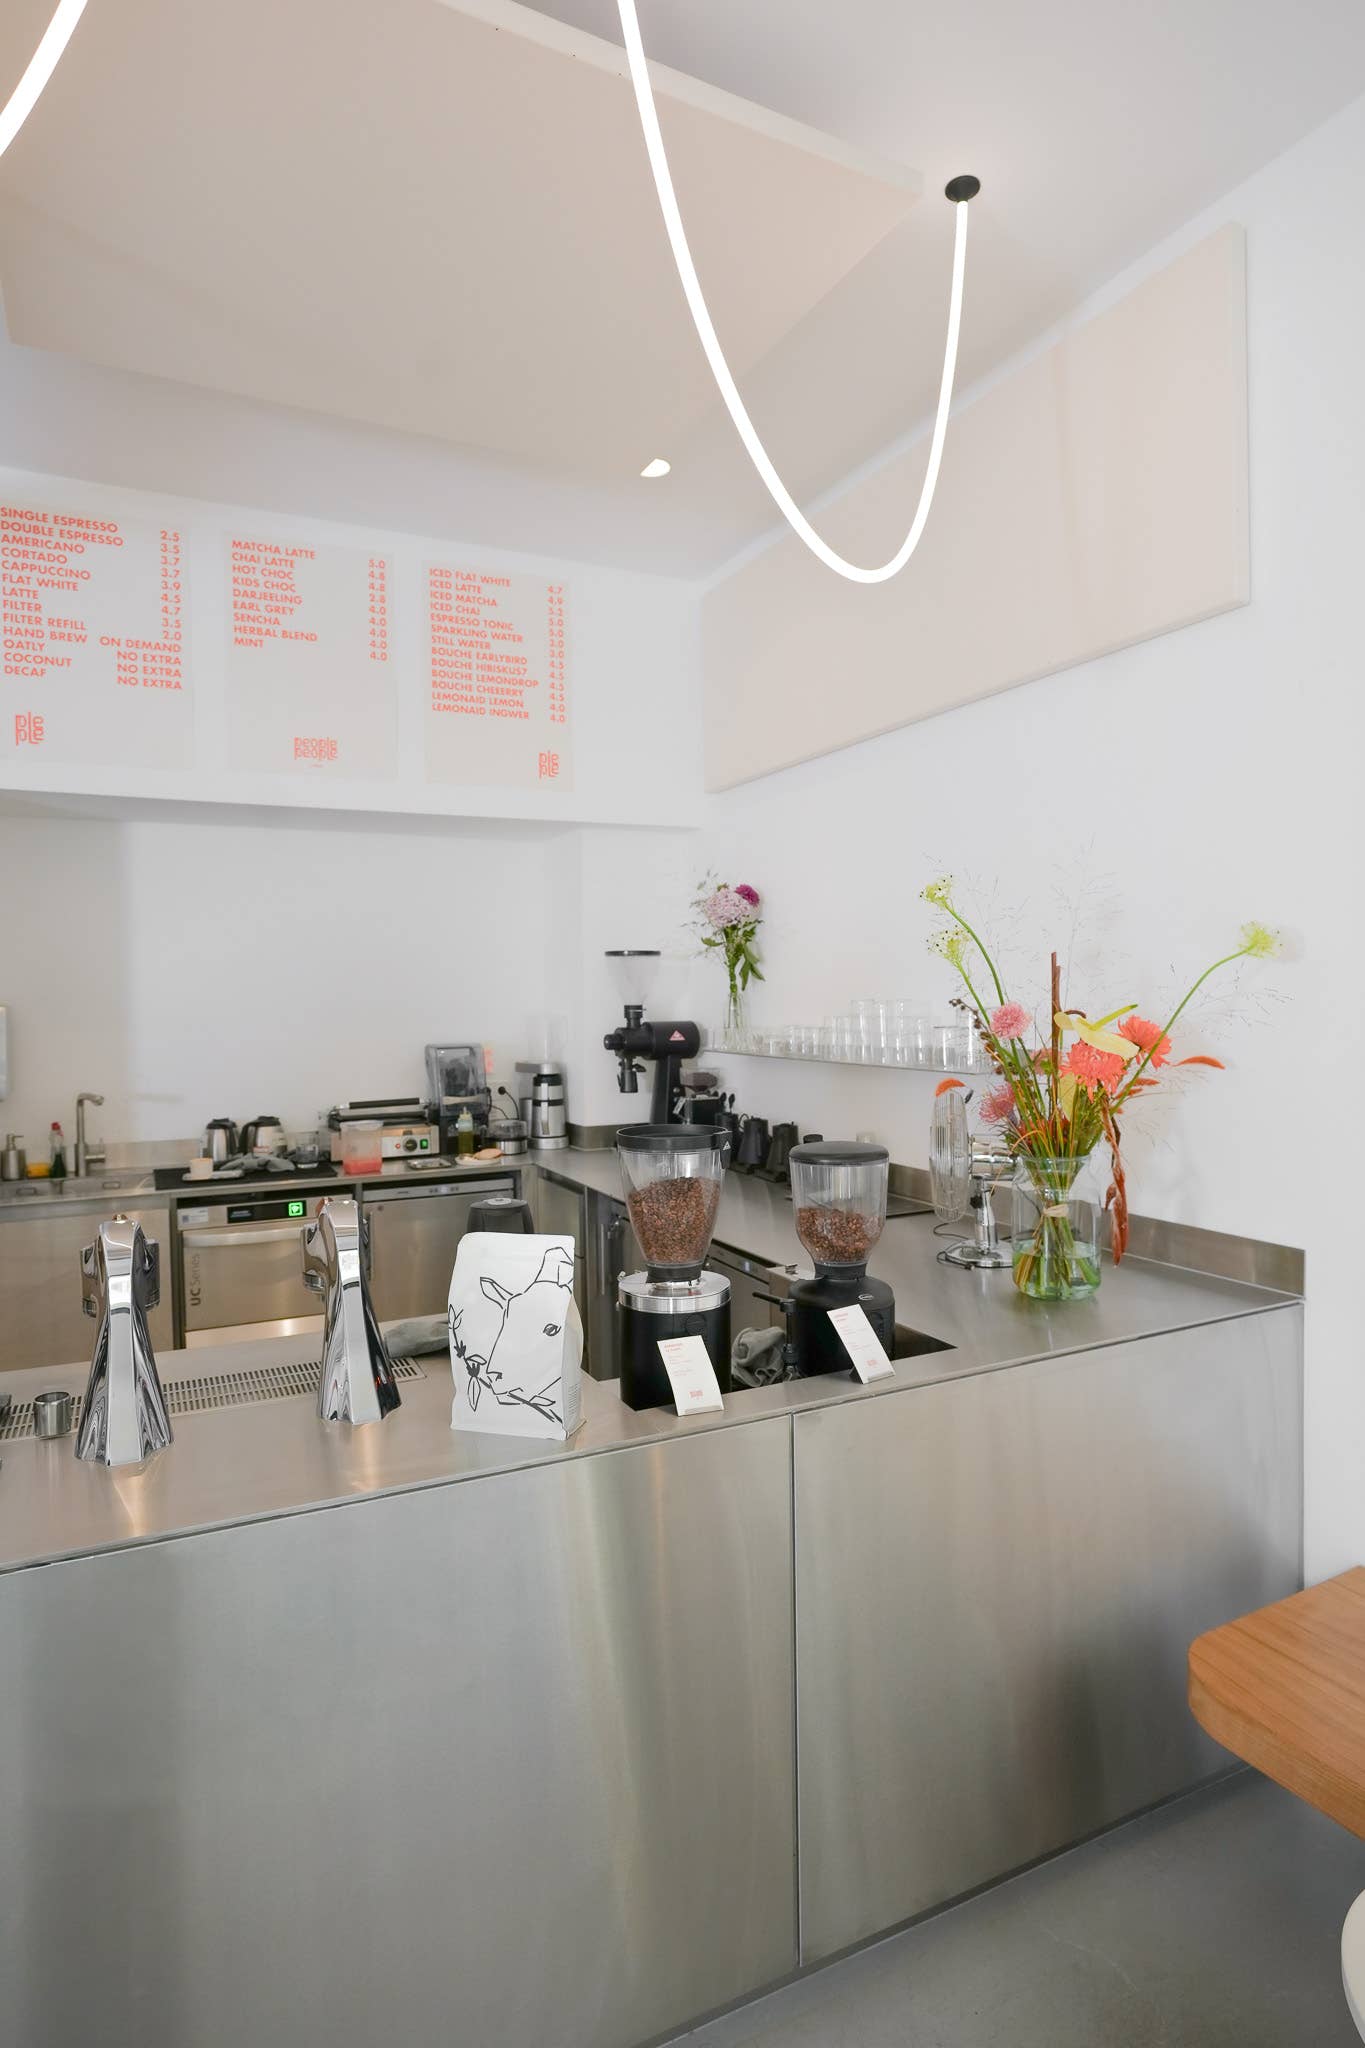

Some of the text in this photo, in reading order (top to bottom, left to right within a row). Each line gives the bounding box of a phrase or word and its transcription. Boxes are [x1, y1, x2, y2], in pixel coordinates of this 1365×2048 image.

[0, 506, 180, 542] SINGLE ESPRESSO 2.5
[0, 520, 180, 554] DOUBLE ESPRESSO 3.5
[1, 534, 180, 566] AMERICANO 3.7
[232, 540, 281, 554] MATCHA
[285, 547, 316, 560] LATTE
[232, 552, 260, 564] CHAI
[264, 556, 295, 568] LATTE
[1, 547, 180, 578] CORTADO 3.7
[232, 564, 257, 575] HOT
[261, 567, 294, 580] CHOC
[1, 560, 181, 591] CAPPUCCINO 3.9
[232, 576, 260, 588] KIDS
[263, 580, 296, 593] CHOC
[430, 568, 452, 578] ICED
[455, 571, 477, 581] FLAT
[481, 576, 511, 587] WHITE
[430, 579, 452, 589] ICED
[455, 583, 482, 593] LATTE
[2, 573, 181, 604] FLAT WHITE 4.5
[430, 591, 452, 600] ICED
[456, 595, 497, 606] MATCHA
[2, 586, 181, 616] LATTE 4.7
[233, 588, 387, 615] DARJEELING 4.0
[431, 602, 453, 612] ICED
[456, 605, 480, 615] CHAI
[3, 599, 182, 629] FILTER 3.5
[233, 600, 387, 627] EARL GREY 4.0
[431, 613, 480, 626] ESPRESSO
[483, 620, 513, 631] TONIC
[3, 612, 182, 641] FILTER REFILL 2.0
[233, 612, 387, 638] SENCHA 4.0
[432, 624, 487, 638] SPARKLING
[491, 631, 523, 643] WATER
[3, 626, 182, 653] HAND BREW ON DEMAND
[234, 625, 388, 650] HERBAL BLEND 4.0
[432, 635, 454, 646] STILL
[458, 639, 490, 650] WATER
[3, 639, 182, 665] OATLY NO EXTRA
[234, 637, 388, 661] MINT 4.0
[432, 647, 472, 659] BOUCHE
[476, 652, 527, 665] EARLYBIRD
[3, 652, 182, 678] COCONUT NO EXTRA
[432, 658, 472, 670] BOUCHE
[4, 665, 183, 690] DECAF NO EXTRA
[432, 669, 472, 681] BOUCHE
[476, 674, 539, 687] LEMONDROP
[432, 680, 472, 692] BOUCHE
[432, 692, 486, 704] LEMONAID
[489, 697, 524, 708] LEMON
[432, 704, 486, 715] LEMONAID
[489, 708, 529, 719] INGWER
[190, 1287, 201, 1306] UC
